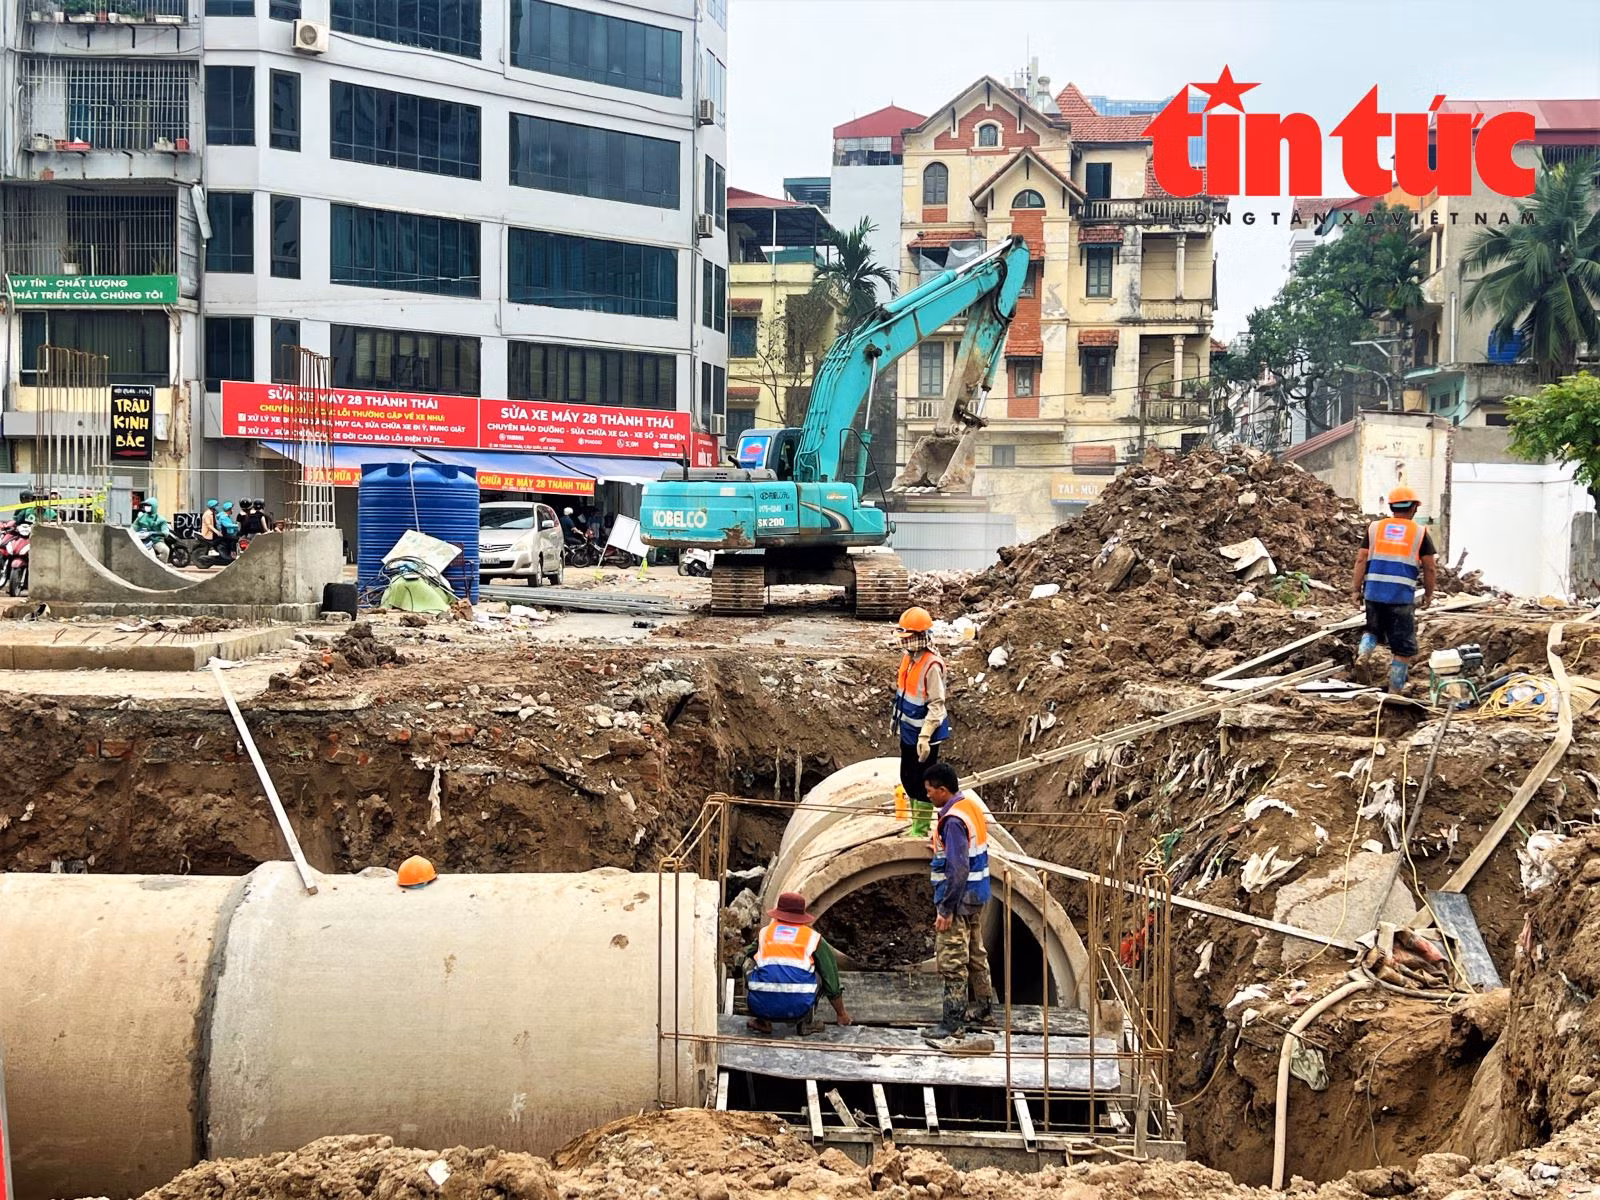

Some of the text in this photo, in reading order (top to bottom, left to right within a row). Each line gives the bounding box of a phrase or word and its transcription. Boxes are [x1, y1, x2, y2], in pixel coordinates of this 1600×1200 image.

[12, 280, 27, 288] UY
[30, 277, 46, 288] TÍN
[56, 277, 86, 288] CHẤT
[89, 280, 128, 289] LƯỢNG
[41, 288, 69, 300] TRIỂN
[73, 289, 97, 300] CỦA
[100, 290, 142, 299] CHÚNG
[145, 290, 163, 299] TÔI
[268, 387, 294, 400] SỬA
[347, 395, 362, 405] 28
[365, 395, 407, 407] THÀNH
[410, 397, 438, 409] THÁI
[114, 398, 149, 413] TRÂU
[113, 415, 148, 429] KINH
[501, 405, 674, 428] SỬA XE MÁY 28 THÀNH THÁI
[487, 423, 518, 431] CHUYÊN
[571, 427, 585, 435] SỬA
[587, 428, 606, 436] CHỮA
[116, 431, 145, 447] BẮC
[480, 475, 501, 485] CHỮA
[504, 478, 514, 486] XE
[516, 478, 534, 488] MÁY
[536, 480, 546, 488] 28
[652, 510, 707, 528] KOBELCO
